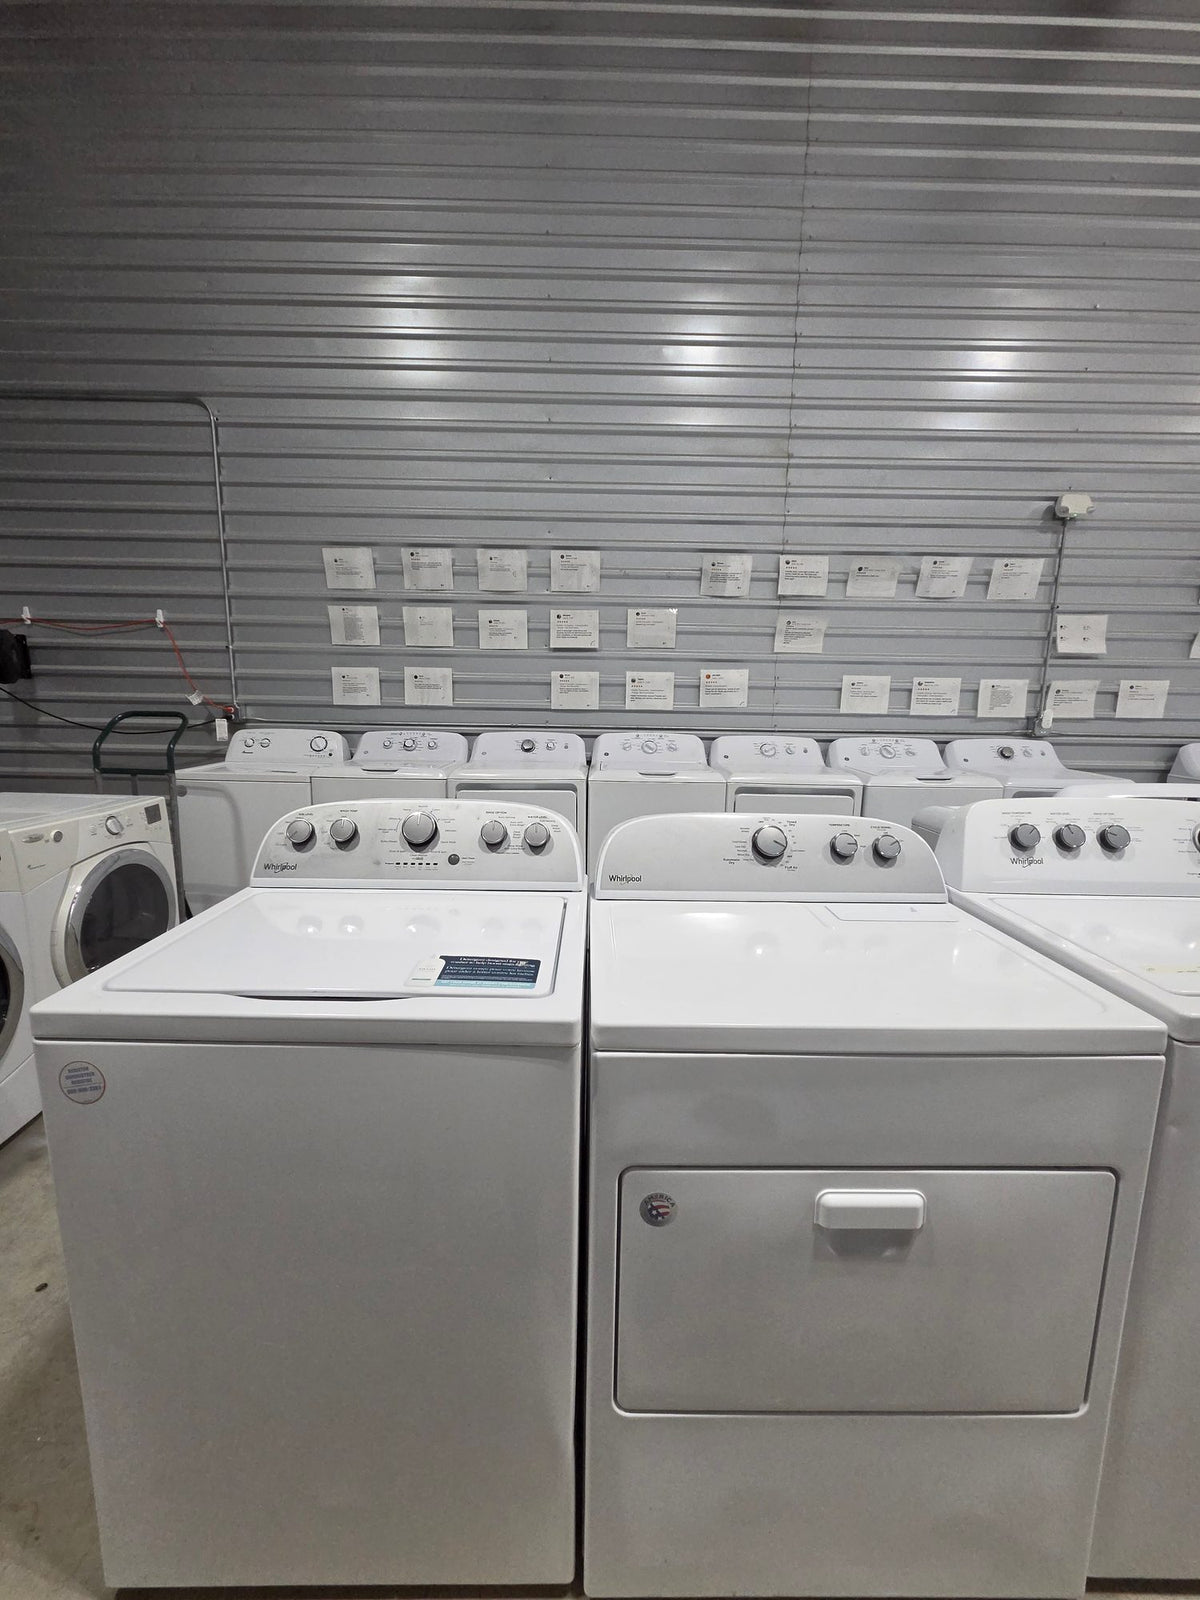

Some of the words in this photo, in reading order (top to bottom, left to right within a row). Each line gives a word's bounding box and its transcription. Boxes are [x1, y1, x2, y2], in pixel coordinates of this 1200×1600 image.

[1010, 857, 1044, 867] Whirlpool
[264, 863, 297, 872] Whirlpool
[609, 875, 642, 884] Whirlpool
